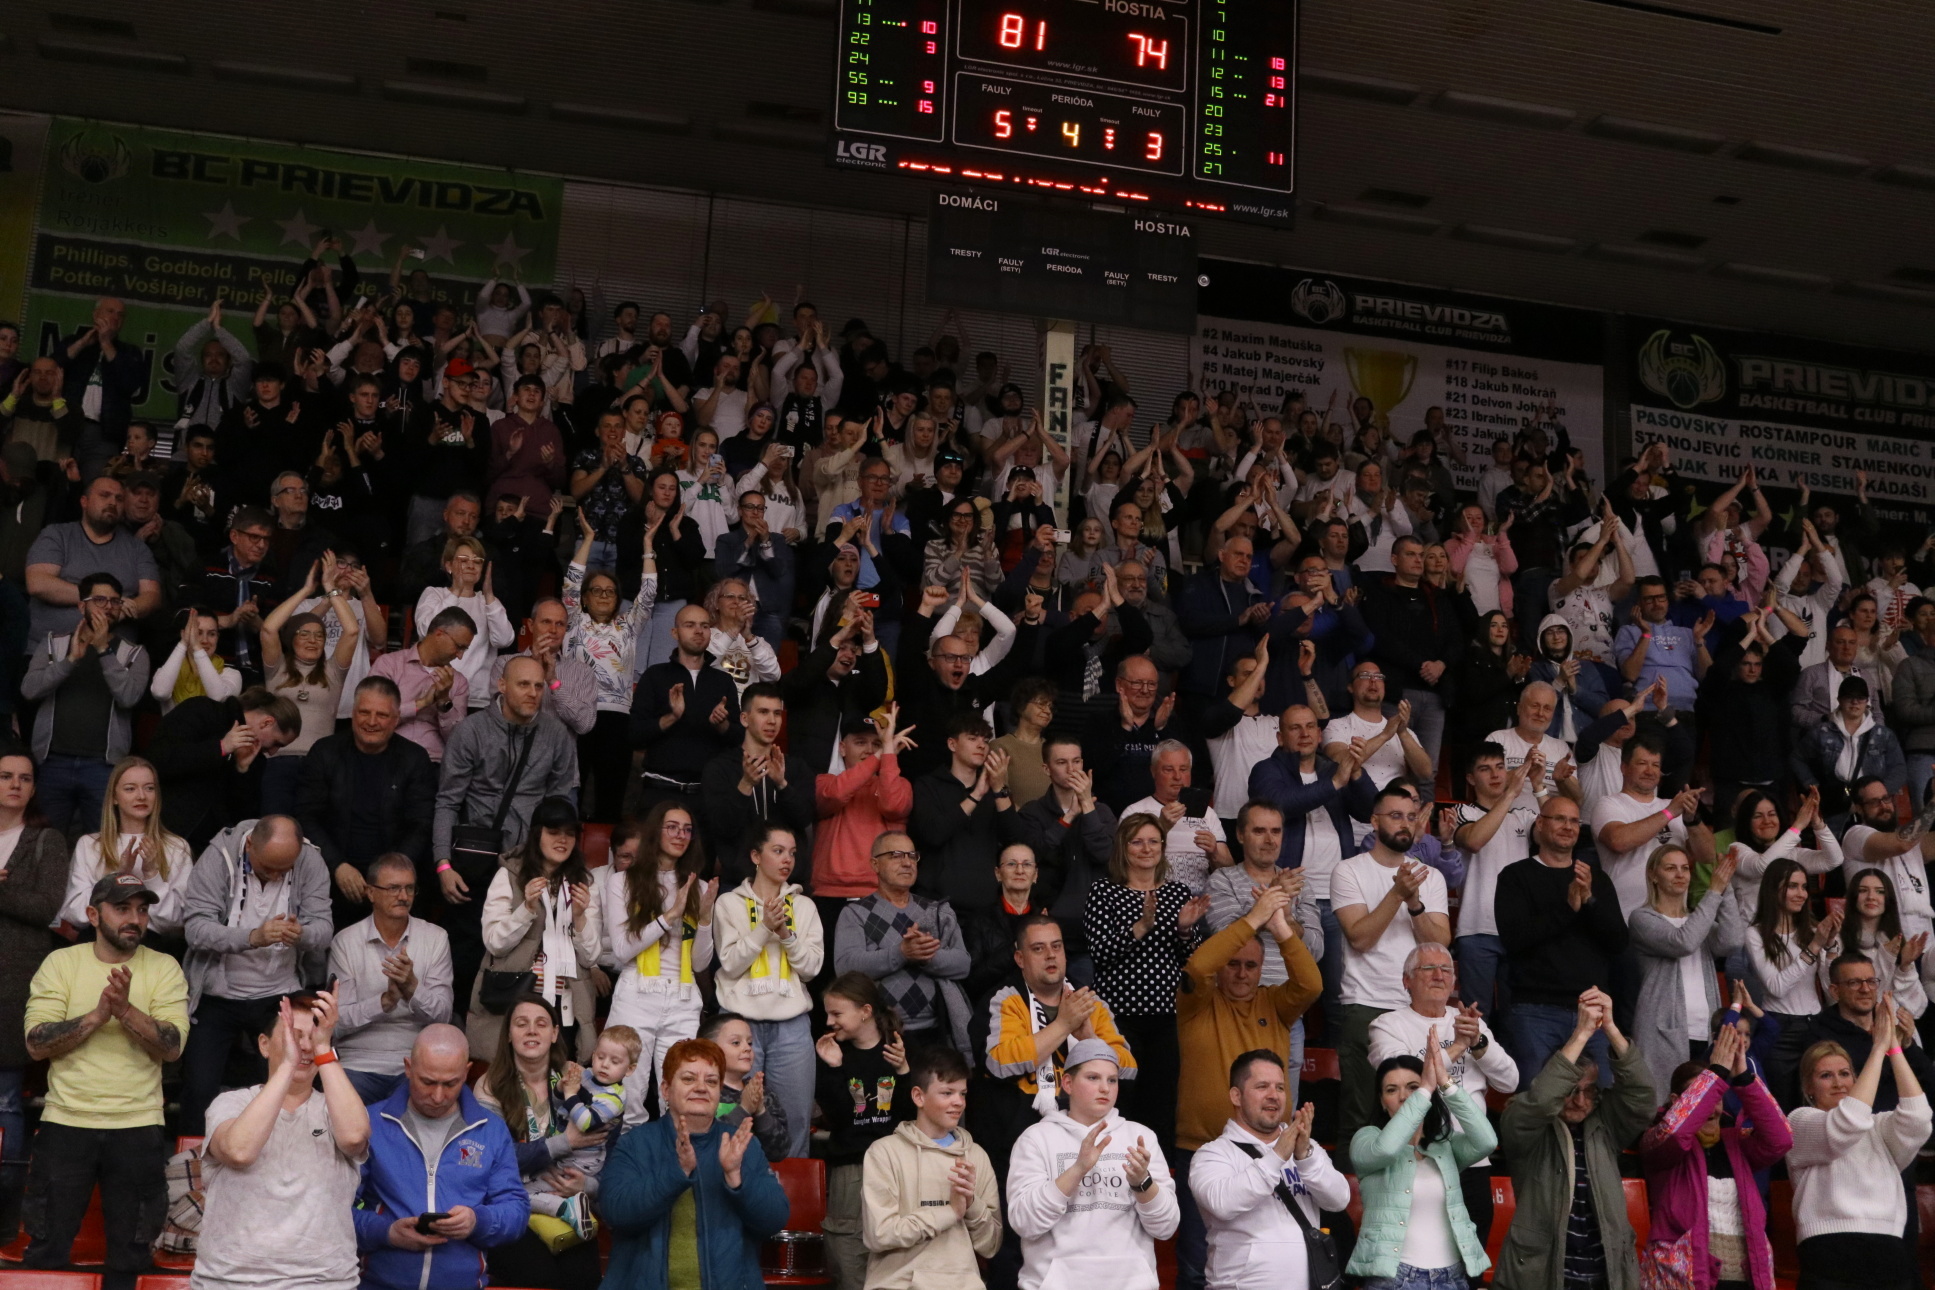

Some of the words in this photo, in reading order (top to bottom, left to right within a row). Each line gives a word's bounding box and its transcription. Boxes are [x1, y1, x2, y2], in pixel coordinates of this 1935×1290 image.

[1105, 0, 1166, 20] HOSTIA
[1217, 11, 1225, 23] 7
[858, 13, 871, 26] 13
[922, 21, 937, 35] 10
[999, 13, 1047, 51] 81
[850, 32, 870, 46] 22
[926, 41, 937, 54] 3
[1213, 29, 1225, 42] 10
[849, 51, 869, 65] 24
[1127, 33, 1168, 70] 74
[1212, 48, 1224, 61] 11
[1271, 56, 1286, 71] 18
[1047, 60, 1099, 74] www.lgr.sk
[848, 71, 868, 85] 55
[924, 80, 935, 94] 9
[1212, 67, 1224, 80] 12
[1271, 75, 1286, 90] 13
[982, 84, 1012, 96] FAULY
[1051, 93, 1094, 108] PERIÓDA
[1211, 86, 1224, 99] 15
[1264, 93, 1285, 108] 21
[848, 91, 867, 105] 93
[919, 99, 934, 114] 15
[1132, 106, 1162, 119] FAULY
[1205, 104, 1223, 118] 20
[994, 110, 1012, 138] 5
[1062, 120, 1080, 147] 4
[1204, 123, 1223, 137] 23
[836, 140, 887, 161] LGR
[1146, 132, 1163, 160] 3
[1204, 142, 1222, 156] 25
[1270, 151, 1284, 166] 11
[836, 157, 887, 169] electronic
[1203, 161, 1222, 175] 27
[152, 149, 231, 185] BC
[239, 157, 545, 221] PRIEVIDZA
[939, 193, 999, 212] DOMÁCI
[1233, 203, 1289, 218] www.lgr.sk
[1134, 219, 1191, 237] HOSTIA
[950, 248, 982, 259] TRESTY
[998, 257, 1024, 268] FAULY
[1041, 247, 1060, 257] LGR
[53, 245, 133, 270] Phillips,
[144, 256, 237, 281] Godbold,
[1000, 265, 1021, 274] (SETY)
[1046, 263, 1083, 275] PERIÓDA
[50, 266, 115, 289] Potter,
[124, 273, 209, 301] Vošlajer,
[1104, 270, 1129, 281] FAULY
[1106, 278, 1127, 288] (SETY)
[1147, 272, 1178, 283] TRESTY
[1353, 294, 1510, 331] PRIEVIDZA
[1203, 327, 1218, 341] #2
[1222, 330, 1264, 346] Maxim
[1269, 334, 1323, 353] Matuška
[1353, 314, 1421, 333] BASKETBALL
[1425, 322, 1452, 337] CLUB
[1456, 327, 1512, 345] PRIEVIDZA
[1203, 344, 1218, 358] #4
[1222, 346, 1261, 362] Jakub
[1266, 351, 1325, 371] Pasovský
[1203, 361, 1218, 374] #5
[1222, 363, 1258, 381] Matej
[1262, 368, 1321, 386] Majerčák
[1445, 358, 1468, 371] #17
[1472, 362, 1498, 378] Filip
[1502, 366, 1538, 381] Bakoš
[1445, 374, 1468, 387] #18
[1471, 378, 1509, 393] Jakub
[1512, 383, 1557, 399] Mokráň
[1445, 390, 1467, 403] #21
[1445, 407, 1467, 421] #23
[1472, 411, 1517, 427] Ibrahim
[1739, 393, 1849, 420] BASKETBALL
[1853, 406, 1897, 425] CLUB
[1472, 428, 1509, 441] Jakub
[1636, 409, 1729, 437] PASOVSKÝ
[1739, 424, 1857, 451] ROSTAMPOUR
[1866, 437, 1921, 458] MARIĆ
[1752, 444, 1822, 466] KÖRNER
[1719, 463, 1779, 484] HUKA
[1865, 475, 1928, 498] KÁDAŠI
